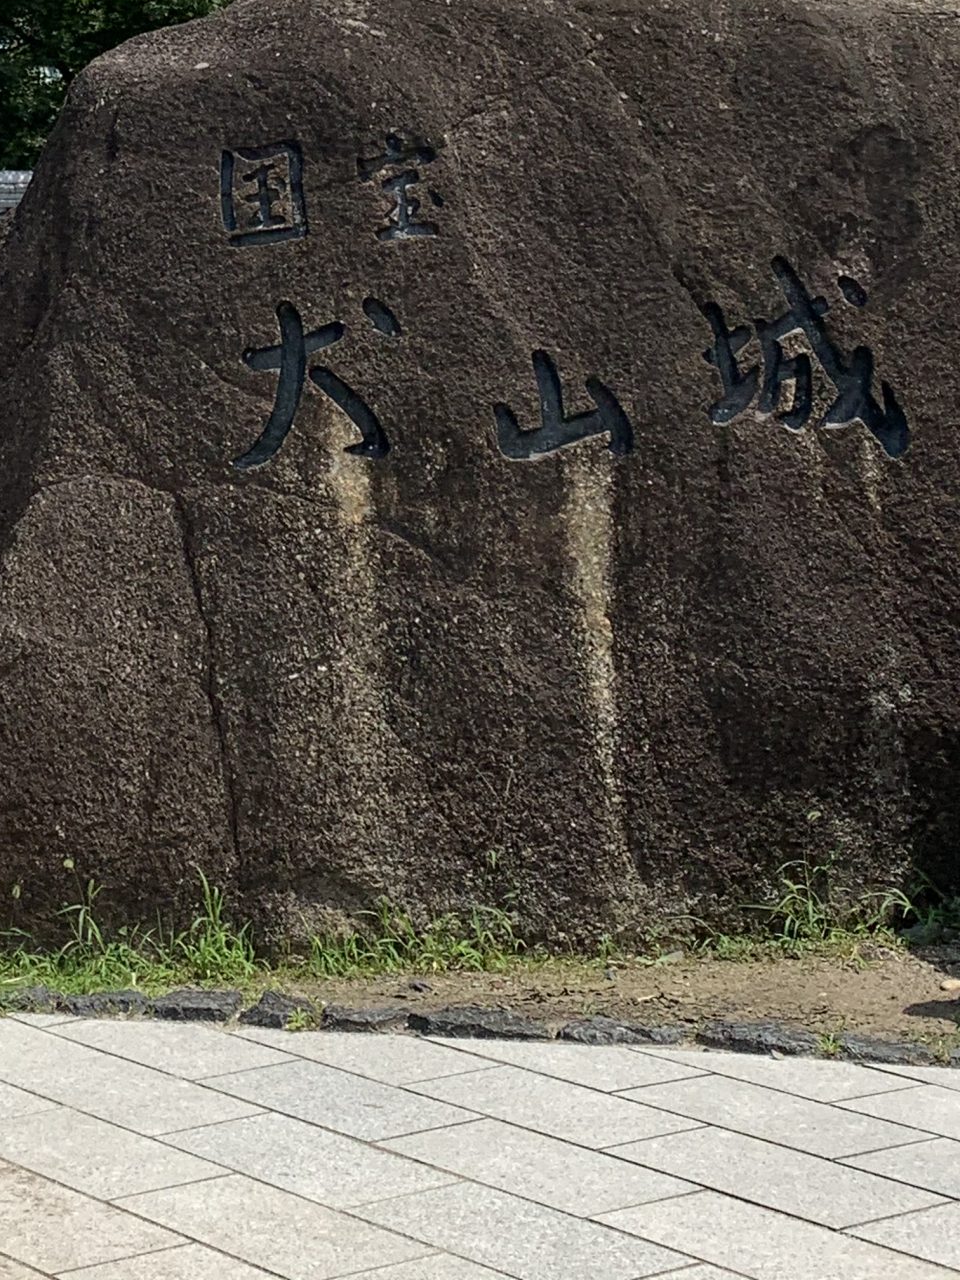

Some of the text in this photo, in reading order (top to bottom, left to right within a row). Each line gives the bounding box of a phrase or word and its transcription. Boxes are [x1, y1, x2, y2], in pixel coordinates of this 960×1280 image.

[221, 133, 444, 247] 国宝
[233, 255, 911, 468] 犬山城
